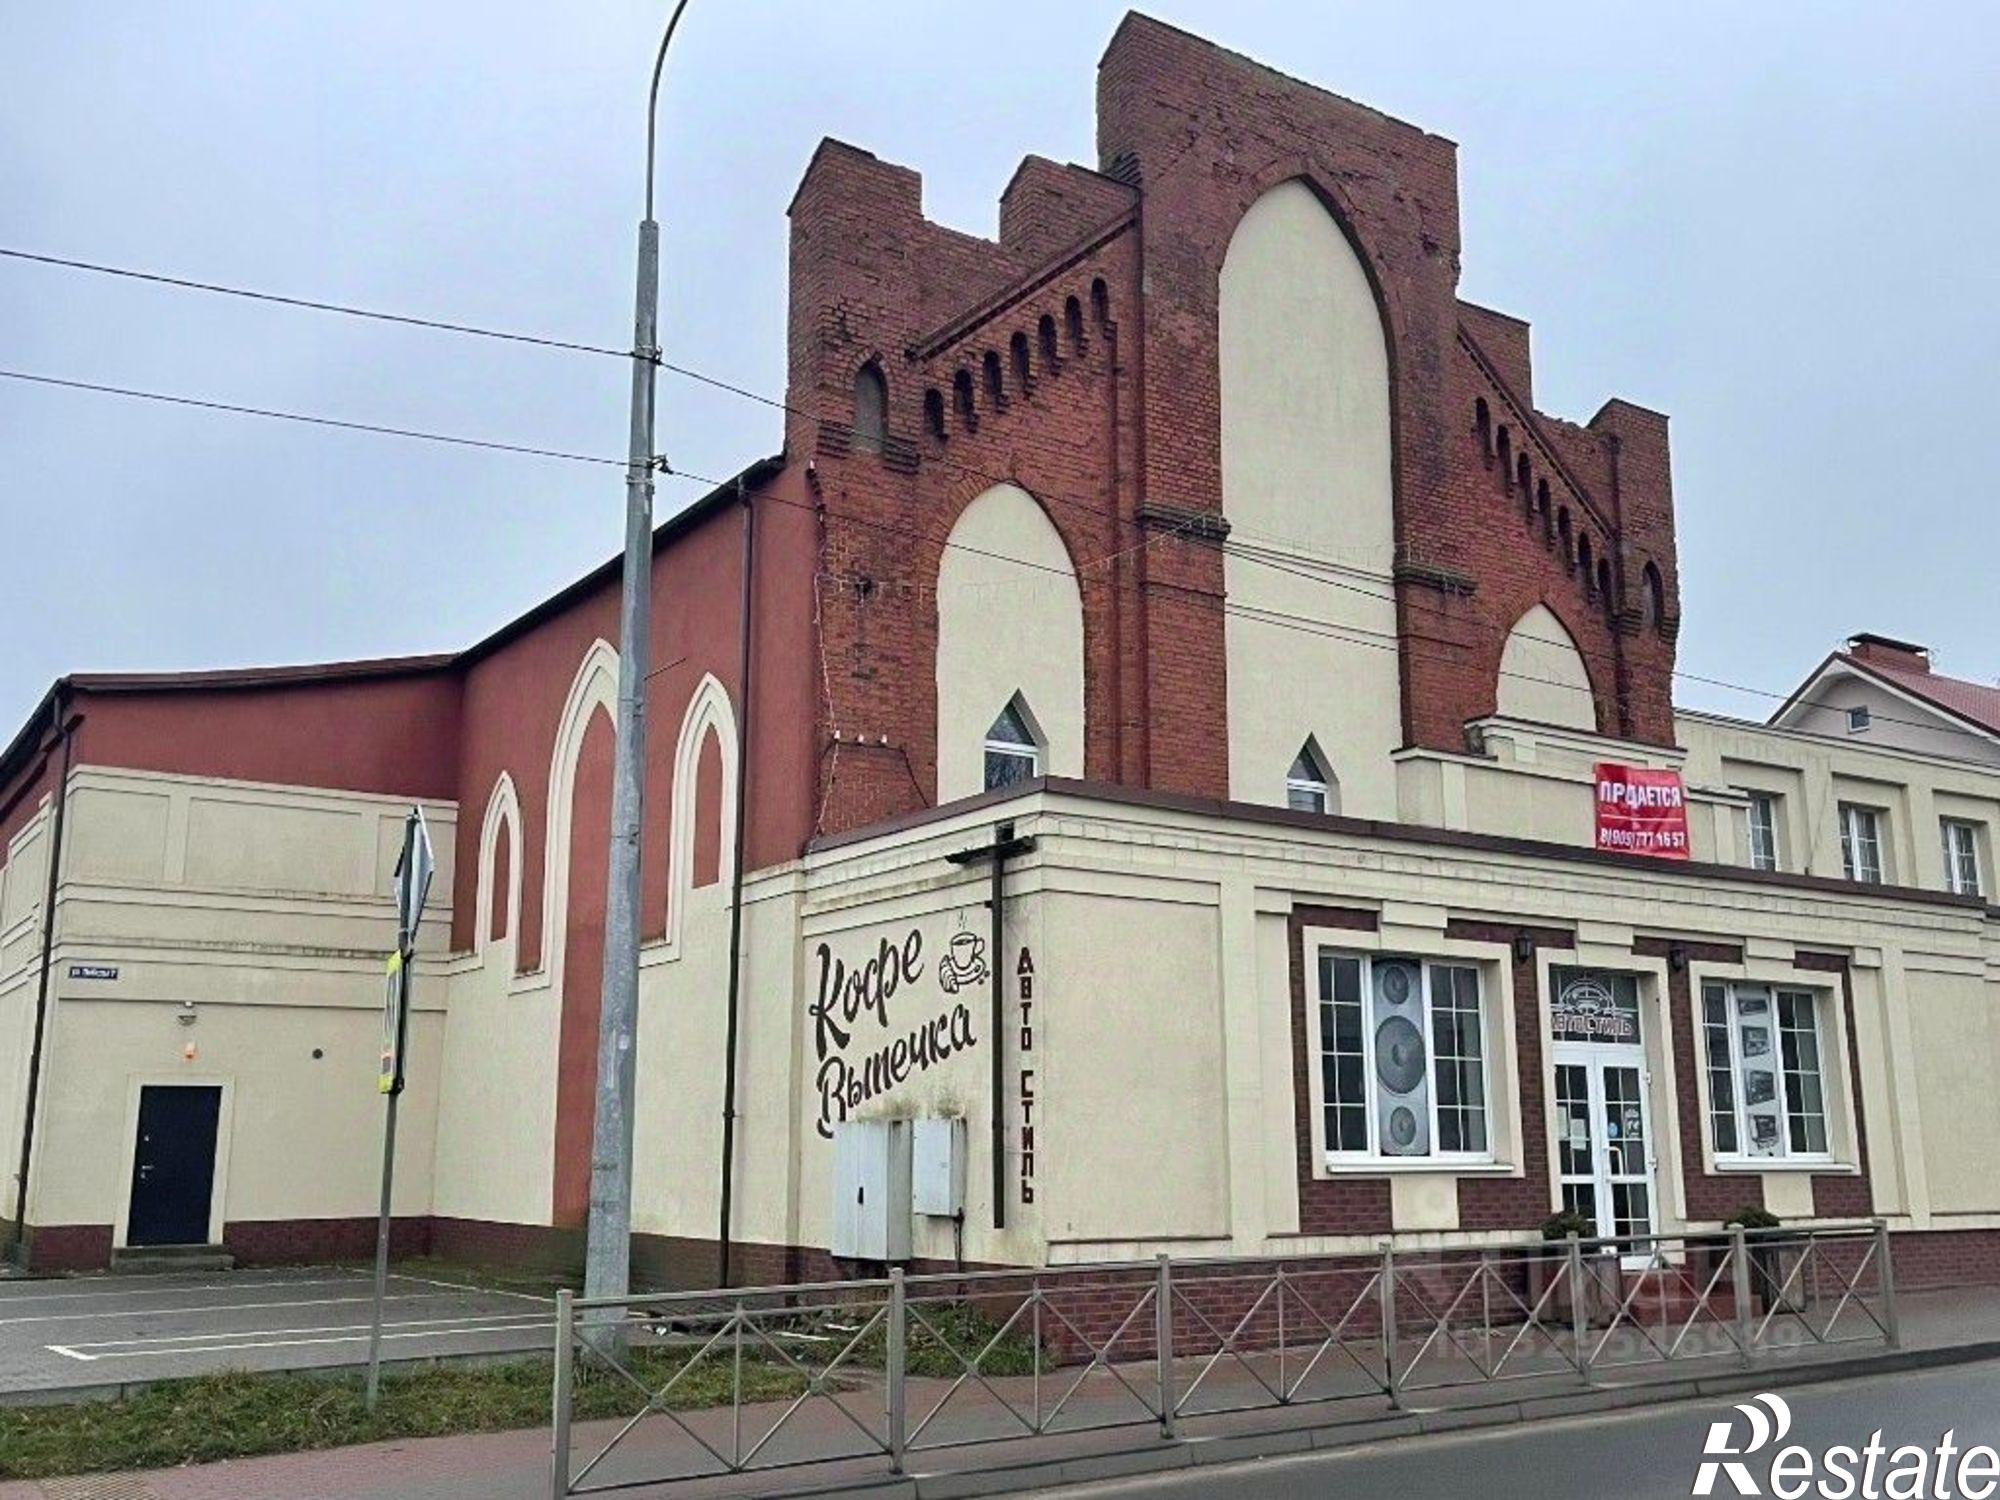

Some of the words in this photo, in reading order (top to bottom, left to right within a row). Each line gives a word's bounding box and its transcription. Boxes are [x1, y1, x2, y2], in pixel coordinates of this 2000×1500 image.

[809, 929, 924, 1062] Кофе
[1017, 946, 1034, 1051] АВТО
[816, 1003, 977, 1139] Выпечка
[1020, 1070, 1034, 1204] СТИЛЬ
